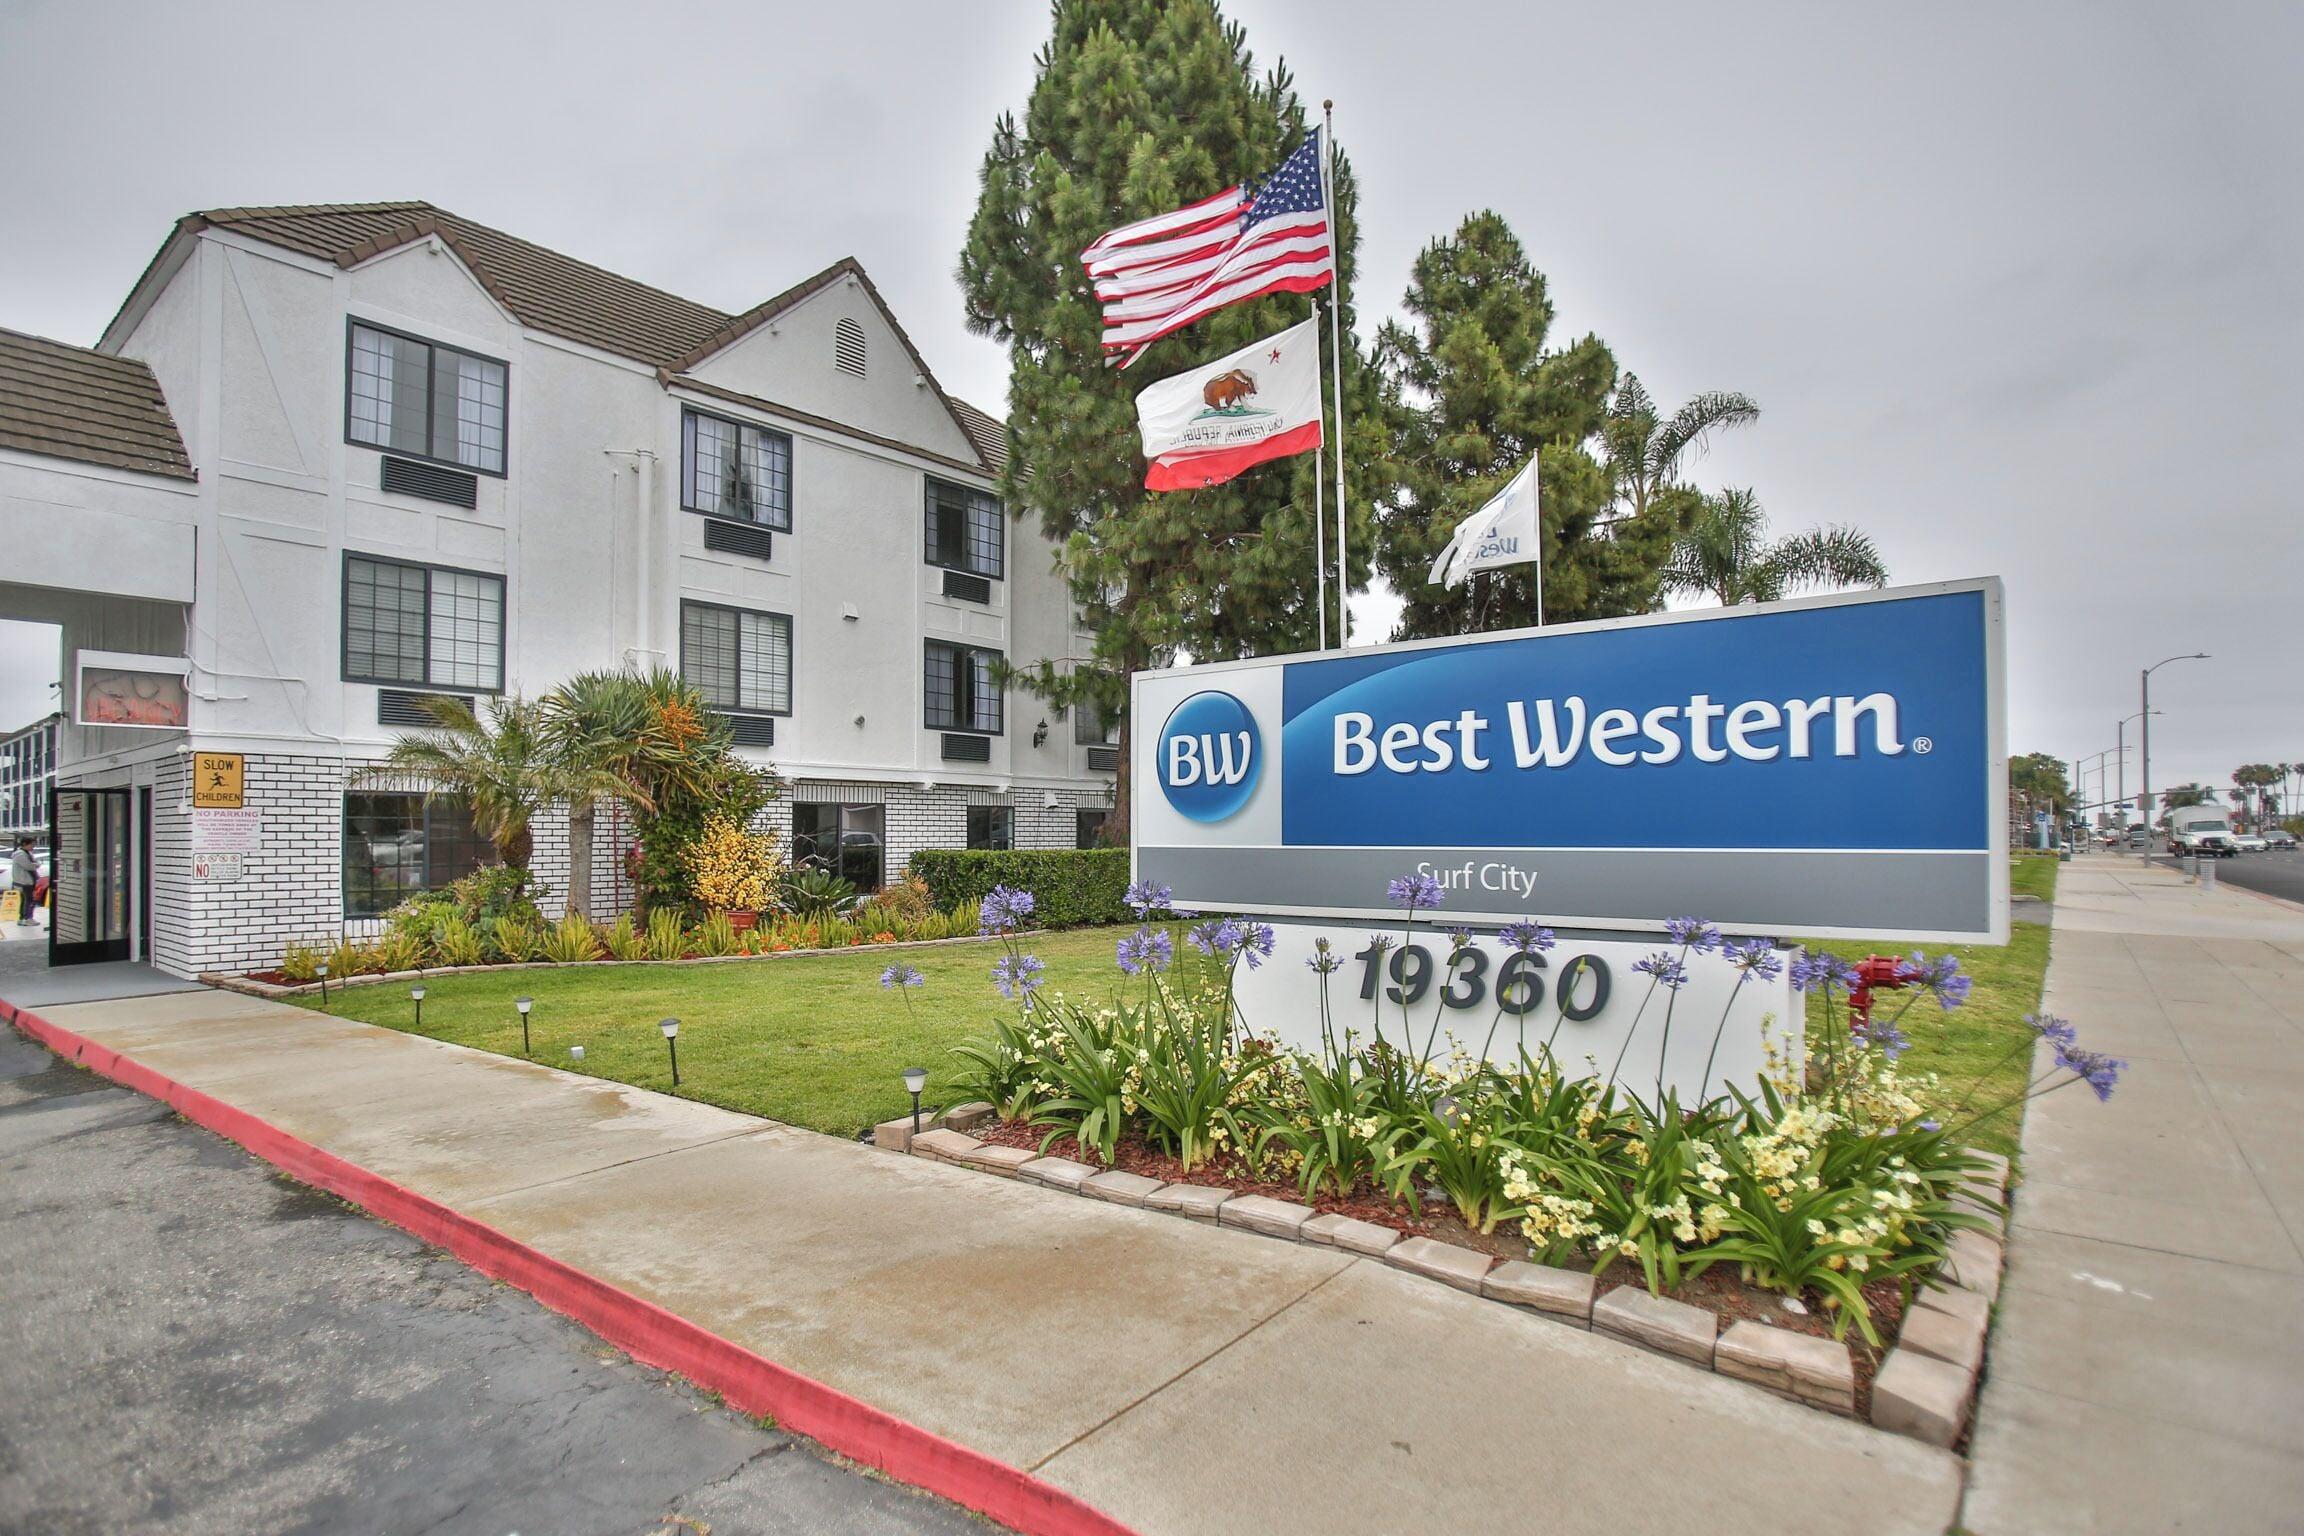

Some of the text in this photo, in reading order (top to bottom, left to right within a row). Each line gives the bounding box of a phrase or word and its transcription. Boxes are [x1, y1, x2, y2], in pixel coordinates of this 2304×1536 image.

[1333, 709, 1491, 776] Best
[1506, 692, 1906, 769] Western
[203, 759, 234, 771] SLOW
[1168, 731, 1253, 787] BW
[196, 791, 240, 802] CHILDREN
[214, 810, 259, 818] PARKING
[196, 863, 210, 878] NO
[1417, 861, 1538, 899] Surf City
[1355, 944, 1612, 1022] 19360
